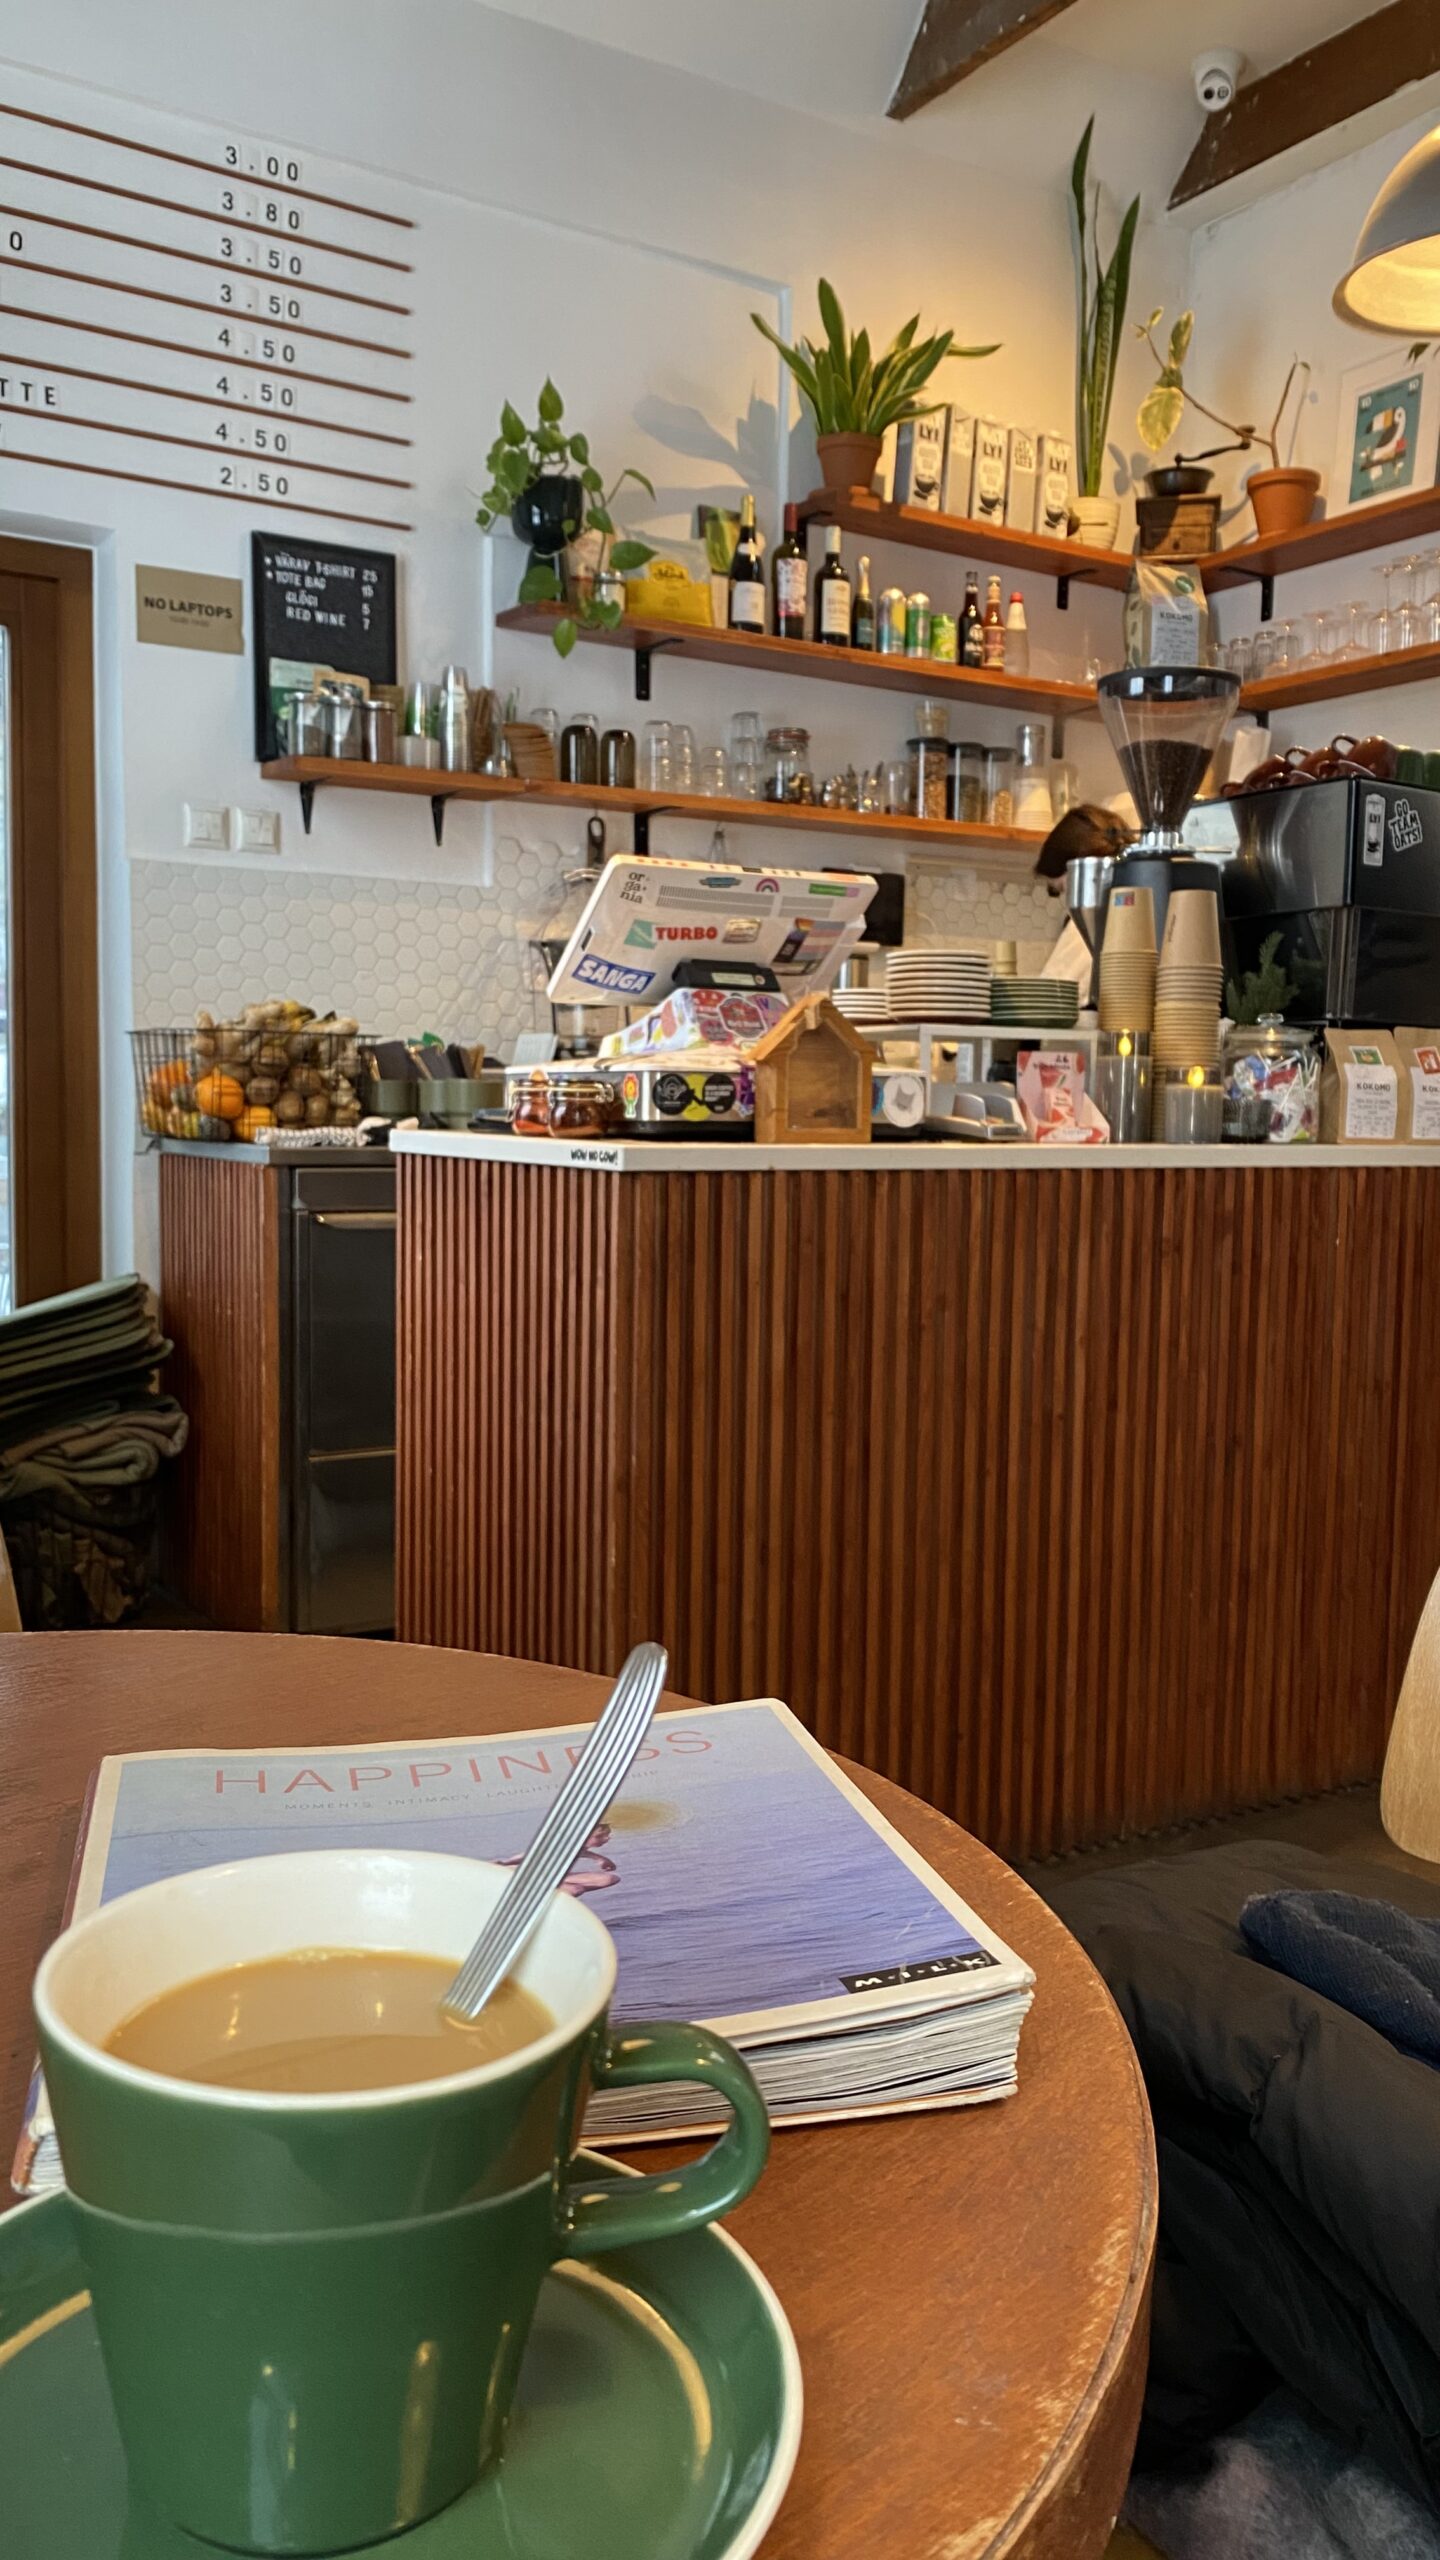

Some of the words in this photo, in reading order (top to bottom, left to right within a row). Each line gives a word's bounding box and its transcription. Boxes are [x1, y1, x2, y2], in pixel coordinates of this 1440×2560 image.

[226, 146, 298, 181] 3.00
[222, 191, 299, 229] 3.80
[221, 237, 301, 275] 3.50
[220, 284, 300, 319] 3.50
[218, 328, 295, 363] 4.50
[216, 376, 293, 407] 4.50
[215, 423, 287, 452] 4.50
[220, 466, 289, 495] 2.50
[275, 570, 301, 587] TOTE
[304, 575, 327, 591] BAG
[143, 596, 167, 610] NO
[168, 599, 233, 619] LAPTOPS
[285, 605, 312, 622] RED
[314, 609, 347, 628] WINE
[362, 617, 371, 631] 7
[1390, 812, 1419, 832] TEAM
[619, 890, 643, 905] nia
[655, 926, 718, 941] TURBO
[577, 959, 650, 992] SANGA
[1356, 1083, 1391, 1093] KOKOMO
[1422, 1085, 1440, 1093] KOK
[486, 1783, 561, 1799] LAUGHT
